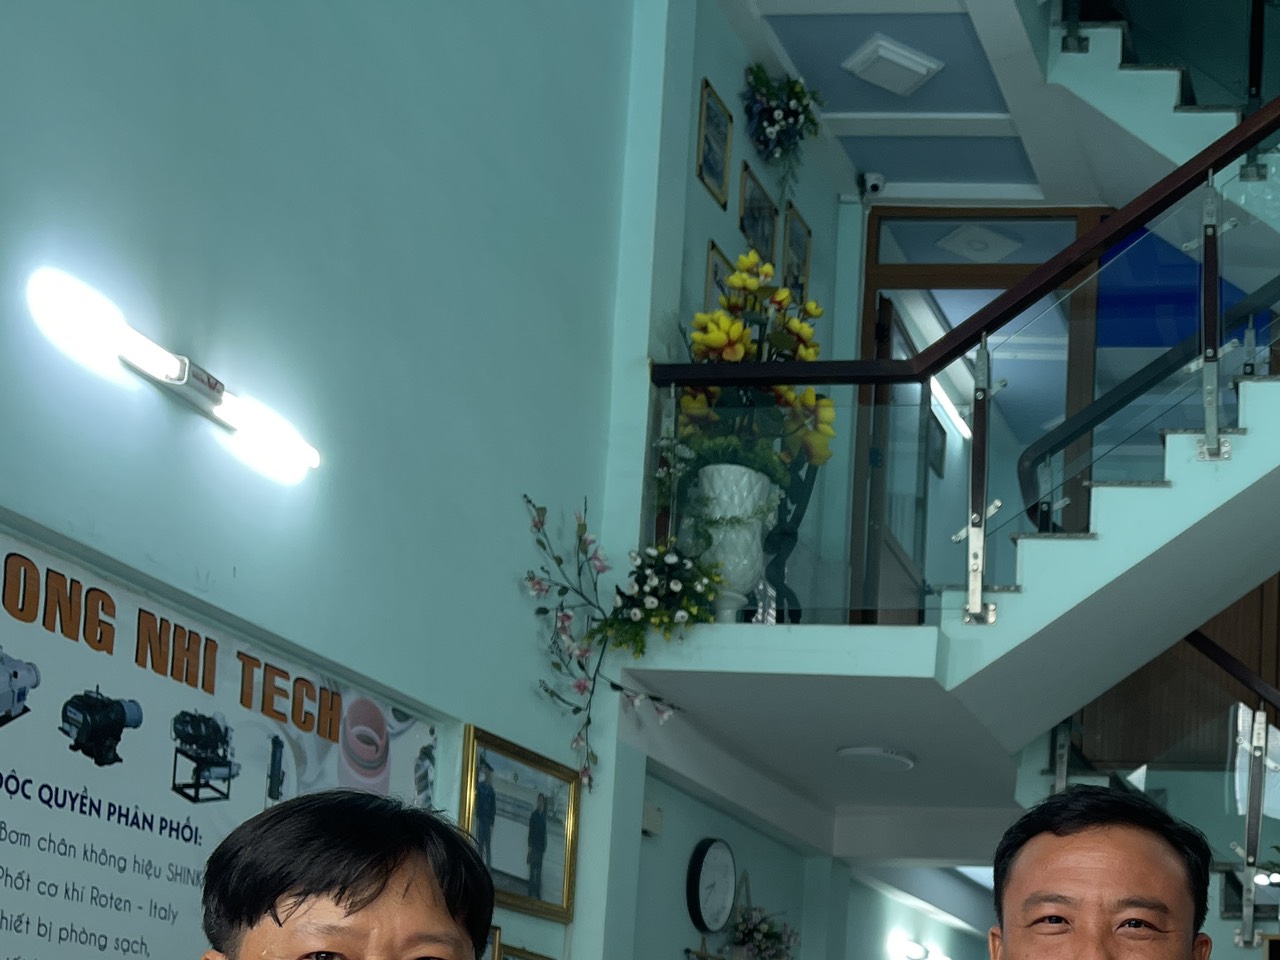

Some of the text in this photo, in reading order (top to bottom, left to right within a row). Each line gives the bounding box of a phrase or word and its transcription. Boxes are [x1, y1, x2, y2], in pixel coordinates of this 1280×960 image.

[135, 607, 218, 696] NHI
[236, 650, 343, 743] TECH
[38, 783, 101, 819] QUYỀN
[107, 801, 154, 833] PHÂN
[159, 815, 203, 846] PHỐI:
[37, 832, 76, 859] chân
[83, 843, 127, 875] không
[133, 854, 162, 880] hiệu
[37, 879, 59, 898] cơ
[64, 881, 86, 903] khí
[90, 886, 132, 914] Roten
[149, 898, 179, 927] Italy
[37, 915, 52, 943] bị
[58, 922, 108, 952] phòng
[114, 935, 151, 959] sạch,
